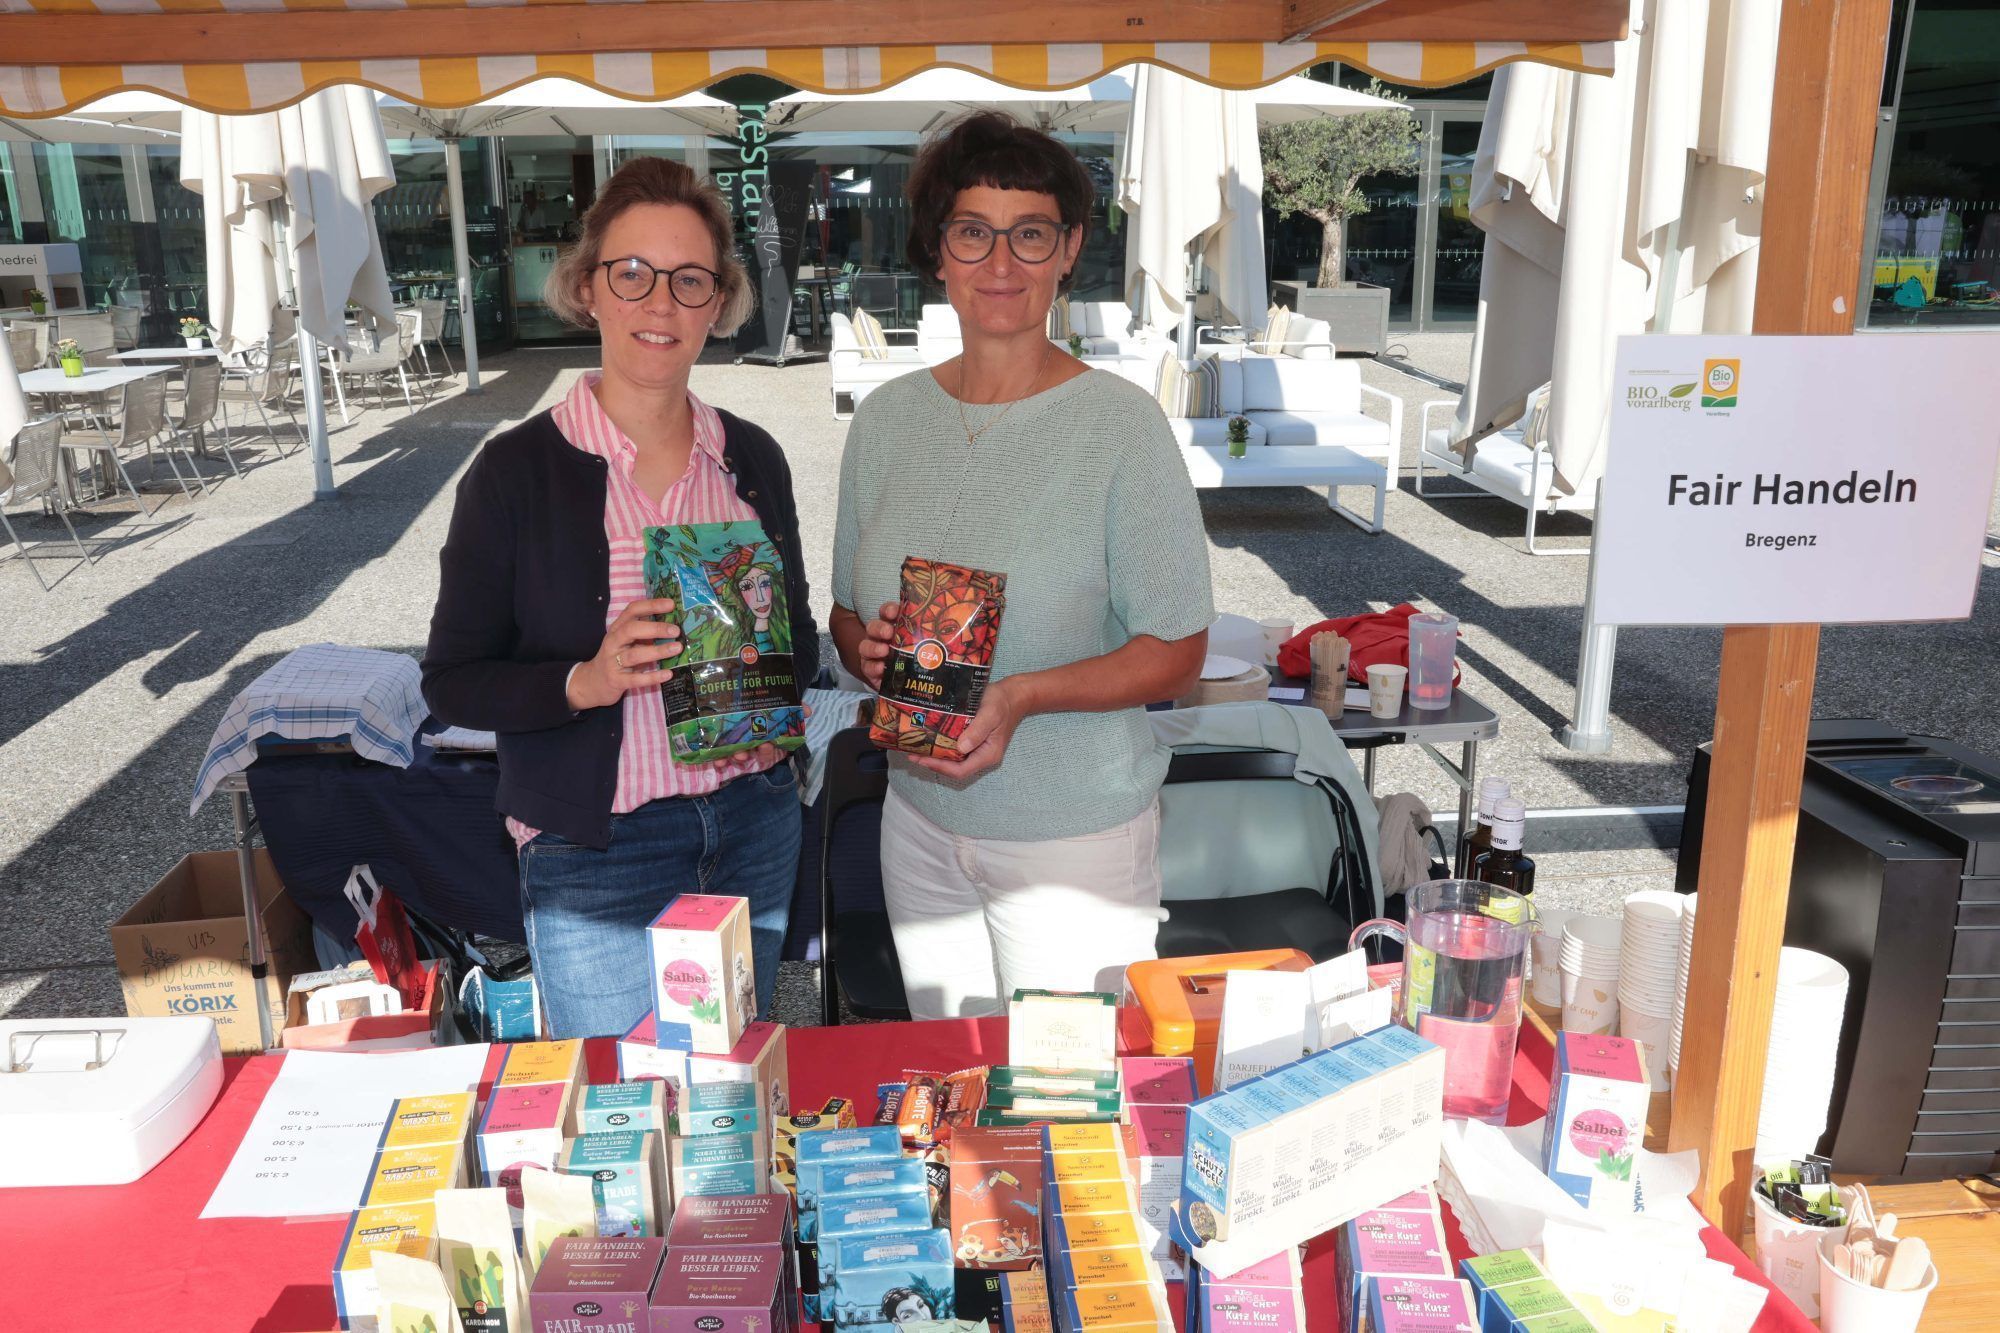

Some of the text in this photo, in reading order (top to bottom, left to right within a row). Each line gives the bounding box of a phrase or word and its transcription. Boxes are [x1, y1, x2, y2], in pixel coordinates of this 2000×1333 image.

[1712, 369, 1731, 381] Bio
[1627, 386, 1658, 399] BIO
[1627, 396, 1692, 412] vorarlberg
[1667, 469, 1918, 506] Fair Handeln
[1745, 531, 1817, 551] Bregenz
[921, 652, 939, 661] EZA
[700, 675, 794, 694] COFFEE FOR FUTURE
[905, 679, 943, 695] JAMBO
[663, 971, 707, 984] Salbei
[164, 984, 181, 993] Uns
[184, 982, 217, 991] kummt
[167, 994, 238, 1014] KÖRIX
[912, 1085, 932, 1120] fairBITE
[1572, 1120, 1623, 1137] Salbei
[1193, 1150, 1224, 1178] SCHUTZ
[1196, 1162, 1219, 1185] ENGEL
[1770, 1172, 1783, 1181] BIO
[1272, 1175, 1295, 1189] Wald-
[603, 1185, 638, 1199] TRADE
[1234, 1191, 1257, 1206] Wald-
[1272, 1189, 1302, 1207] direkt.
[694, 1198, 773, 1208] FAIR HANDELN.
[693, 1206, 769, 1217] BESSER LEBEN.
[1234, 1206, 1265, 1224] direkt.
[1371, 1231, 1421, 1240] Kutz Kutz
[565, 1242, 646, 1250] FAIR HANDELN.
[562, 1251, 641, 1260] BESSER LEBEN.
[681, 1255, 764, 1263] FAIR HANDELN.
[680, 1264, 761, 1273] BESSER LEBEN.
[576, 1308, 600, 1316] Partner
[1396, 1301, 1450, 1313] Kutz Kutz
[1226, 1311, 1280, 1321] Kutz Kutz
[544, 1319, 636, 1333] FAIR TRADE
[697, 1322, 721, 1330] Partner
